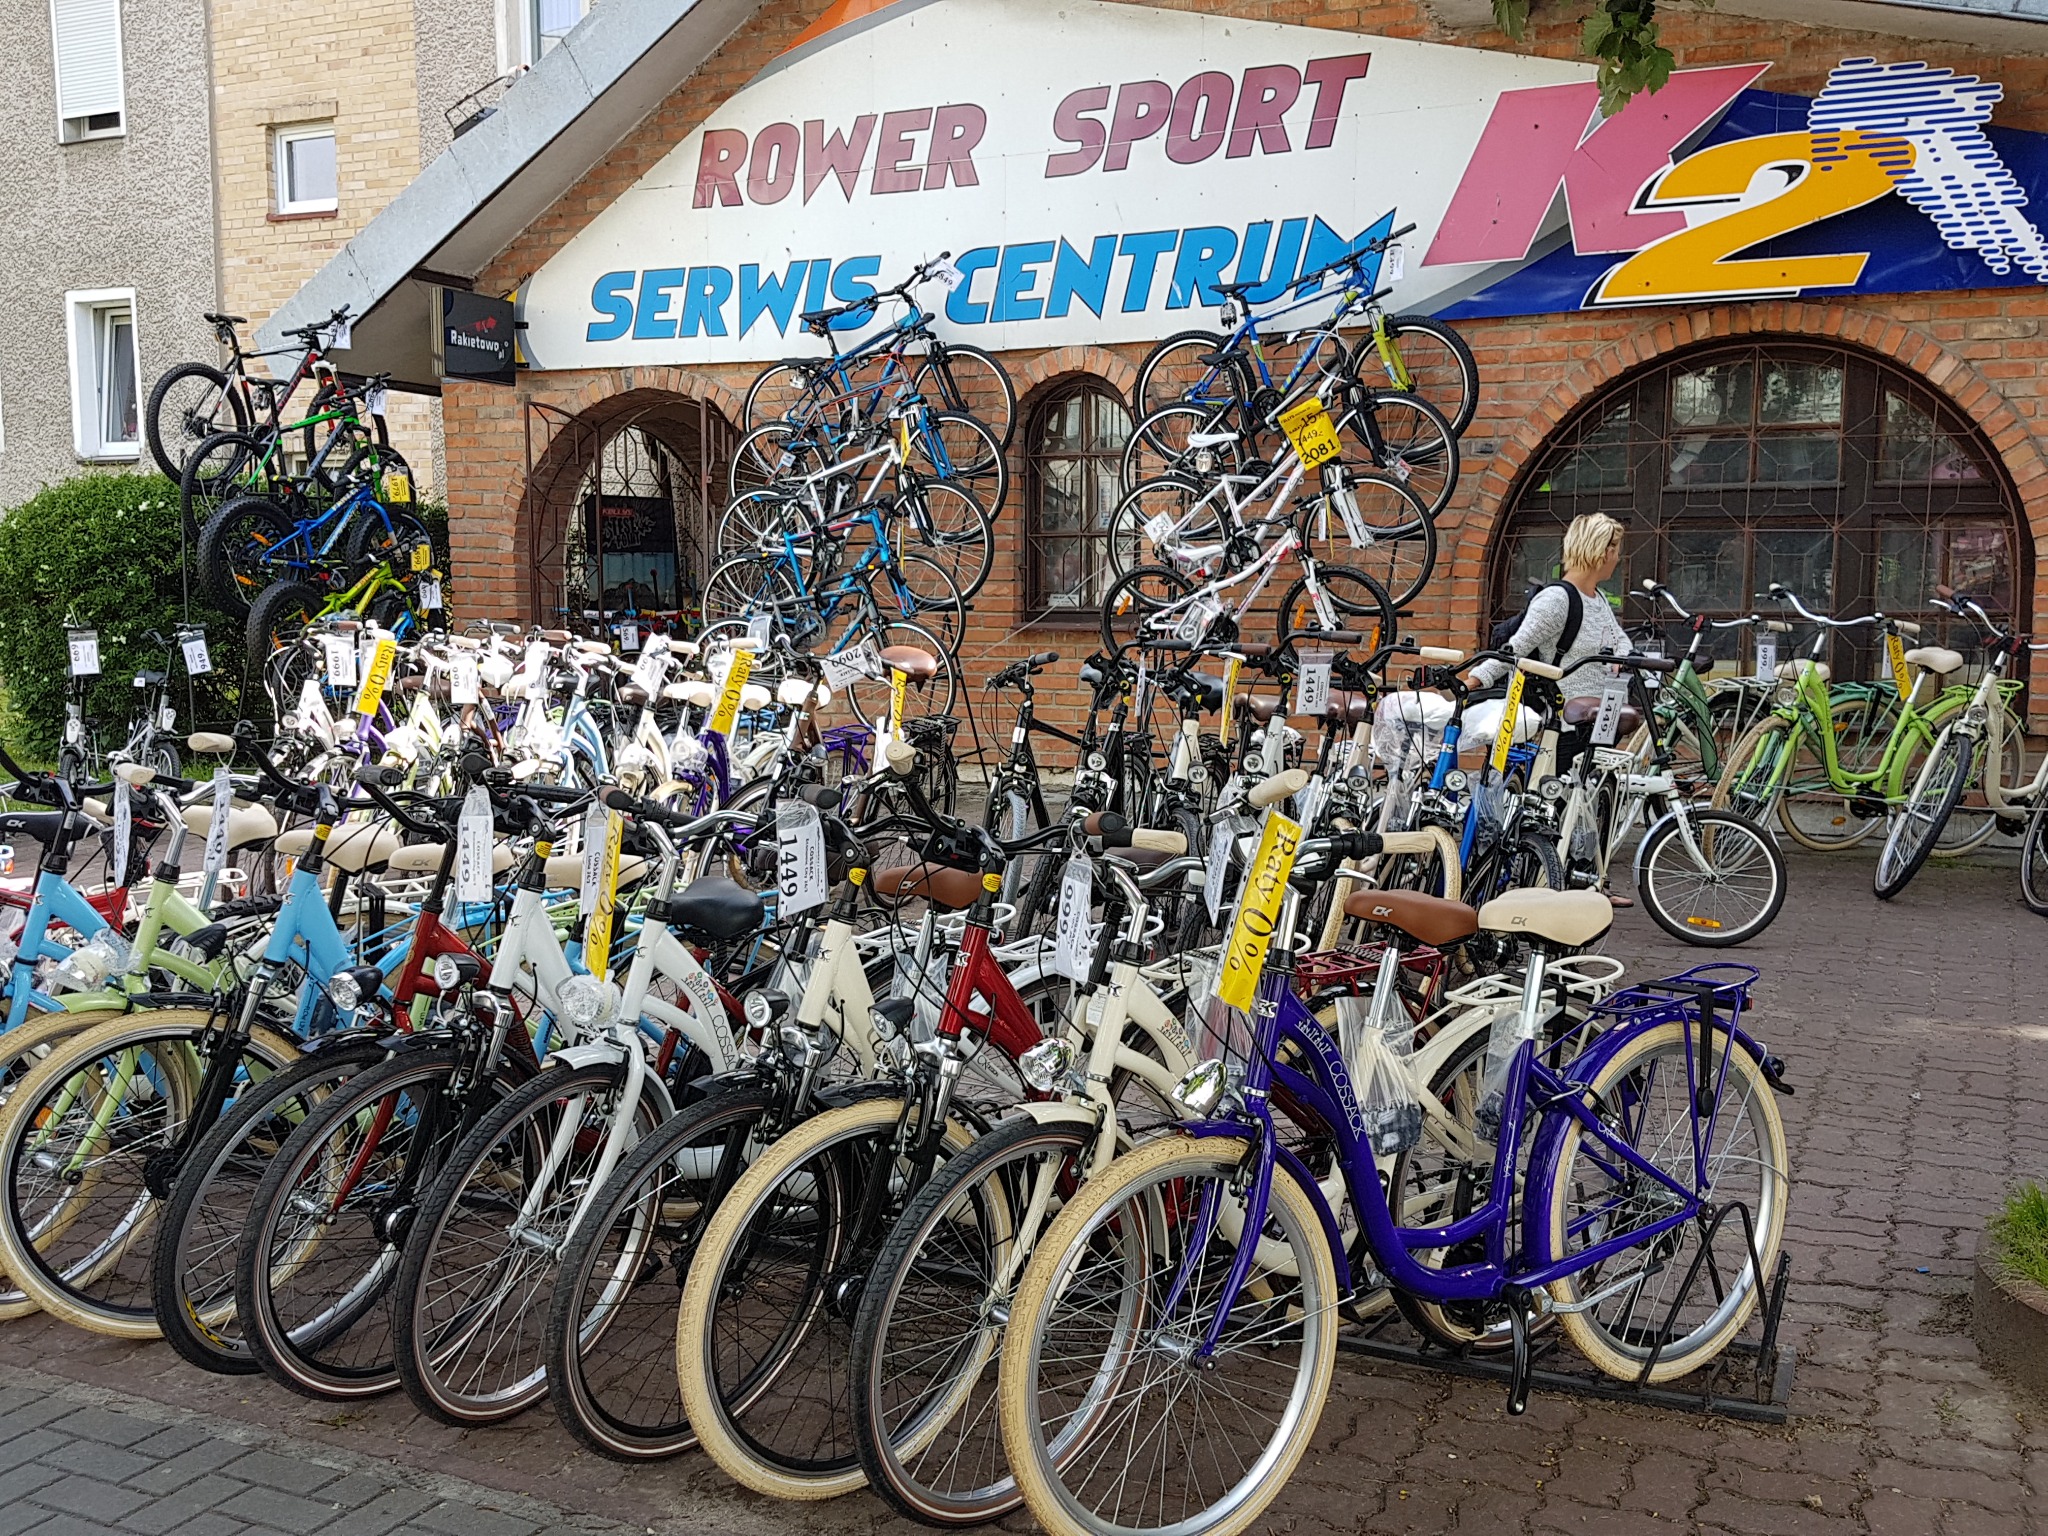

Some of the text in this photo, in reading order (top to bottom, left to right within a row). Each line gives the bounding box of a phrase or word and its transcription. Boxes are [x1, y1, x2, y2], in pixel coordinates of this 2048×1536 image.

[692, 52, 1372, 209] ROWER SPORT
[585, 207, 1399, 342] SERWIS CENTRUM
[450, 329, 500, 352] Rakietowo
[376, 644, 396, 670] Raty
[1229, 830, 1298, 975] Raty 0%
[712, 1014, 738, 1071] COSSAC
[1329, 1060, 1366, 1143] COSSACK
